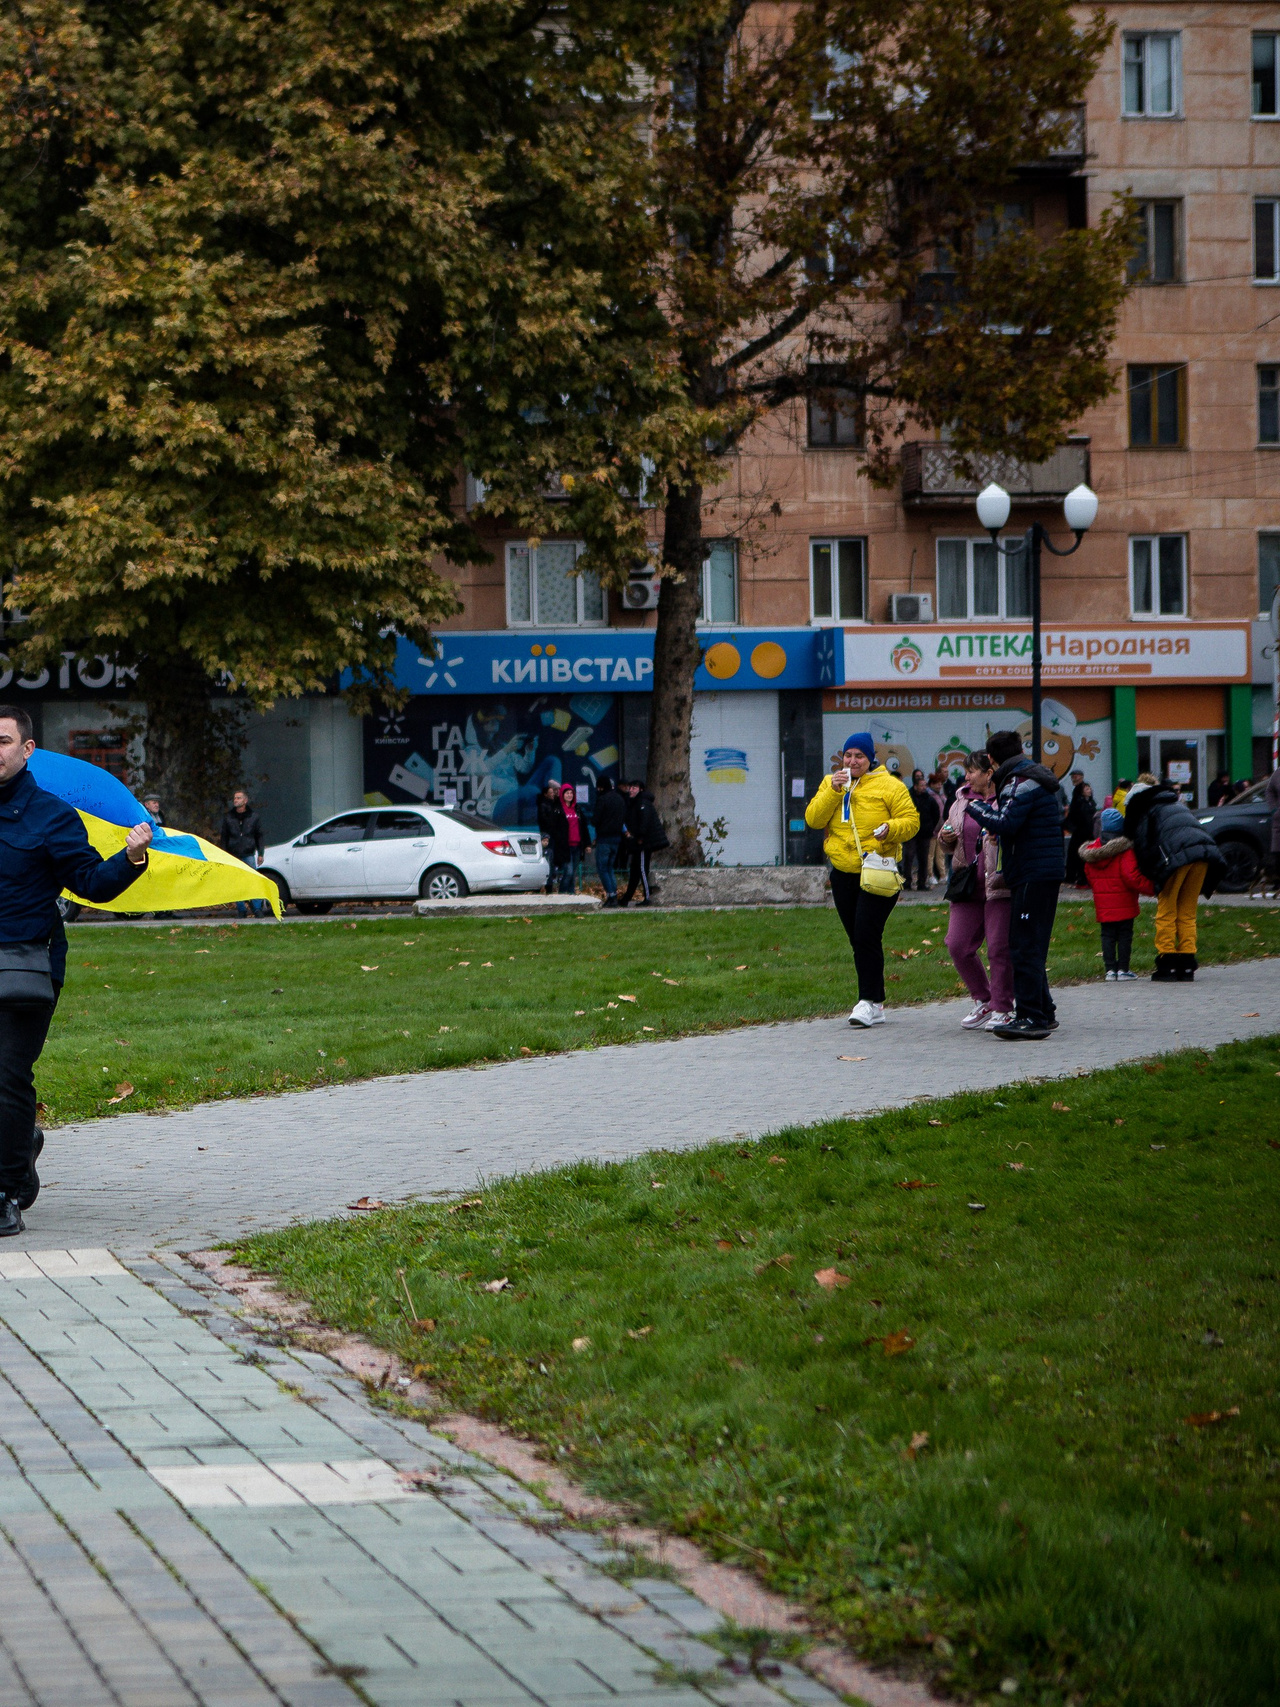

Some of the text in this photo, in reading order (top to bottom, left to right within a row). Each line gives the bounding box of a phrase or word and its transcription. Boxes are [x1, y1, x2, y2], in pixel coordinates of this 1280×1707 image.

[936, 635, 1190, 660] АПТЕКА Народная
[491, 644, 654, 683] КИЇВСТАР
[975, 664, 1120, 675] сеть социльных аптек
[835, 693, 1006, 710] Народная аптека
